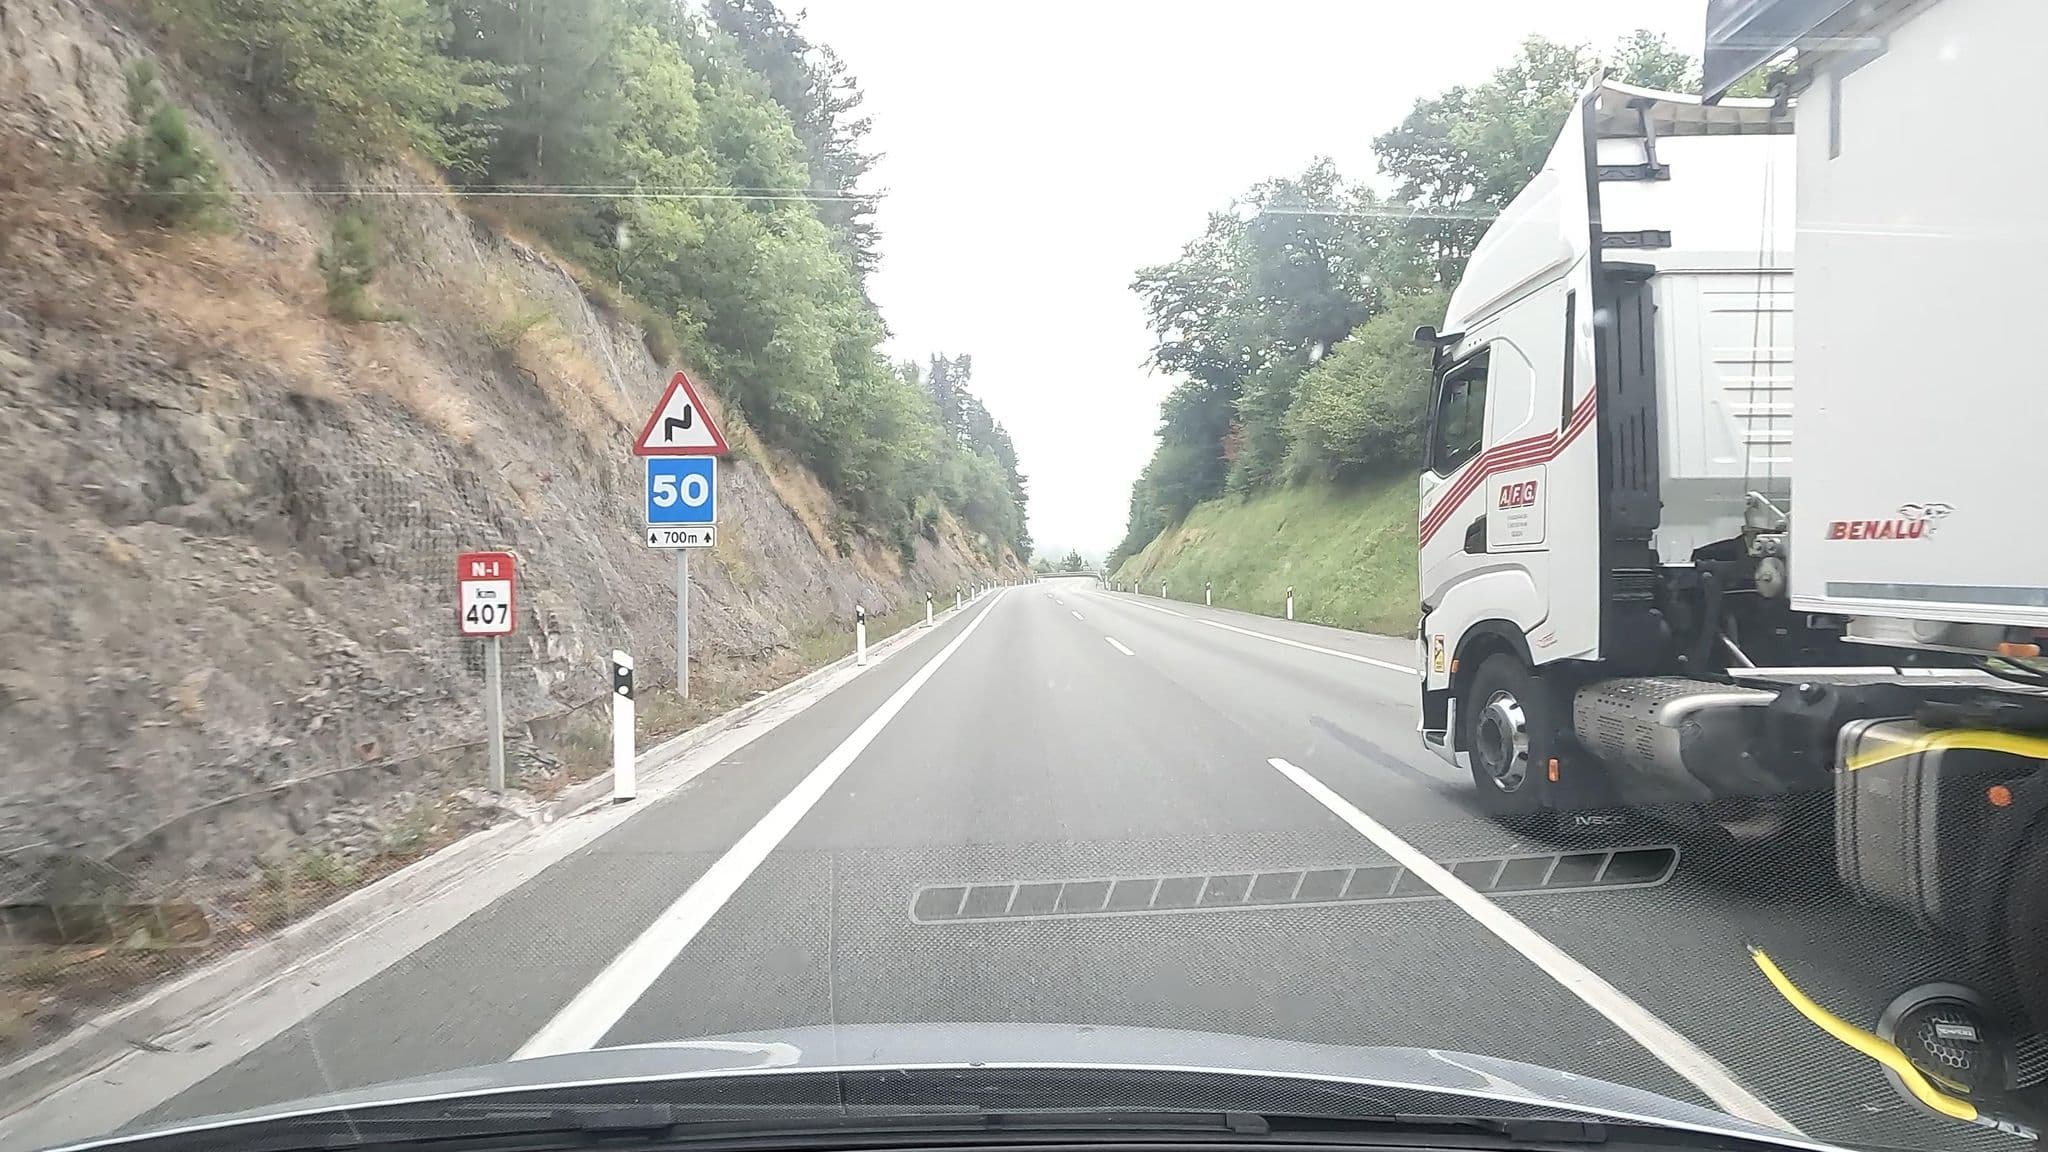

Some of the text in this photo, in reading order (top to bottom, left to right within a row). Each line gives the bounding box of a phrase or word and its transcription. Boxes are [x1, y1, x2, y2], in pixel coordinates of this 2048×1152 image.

[653, 473, 709, 508] 50
[664, 531, 698, 544] 700m
[1830, 520, 1925, 540] BENALU
[466, 604, 508, 625] 407
